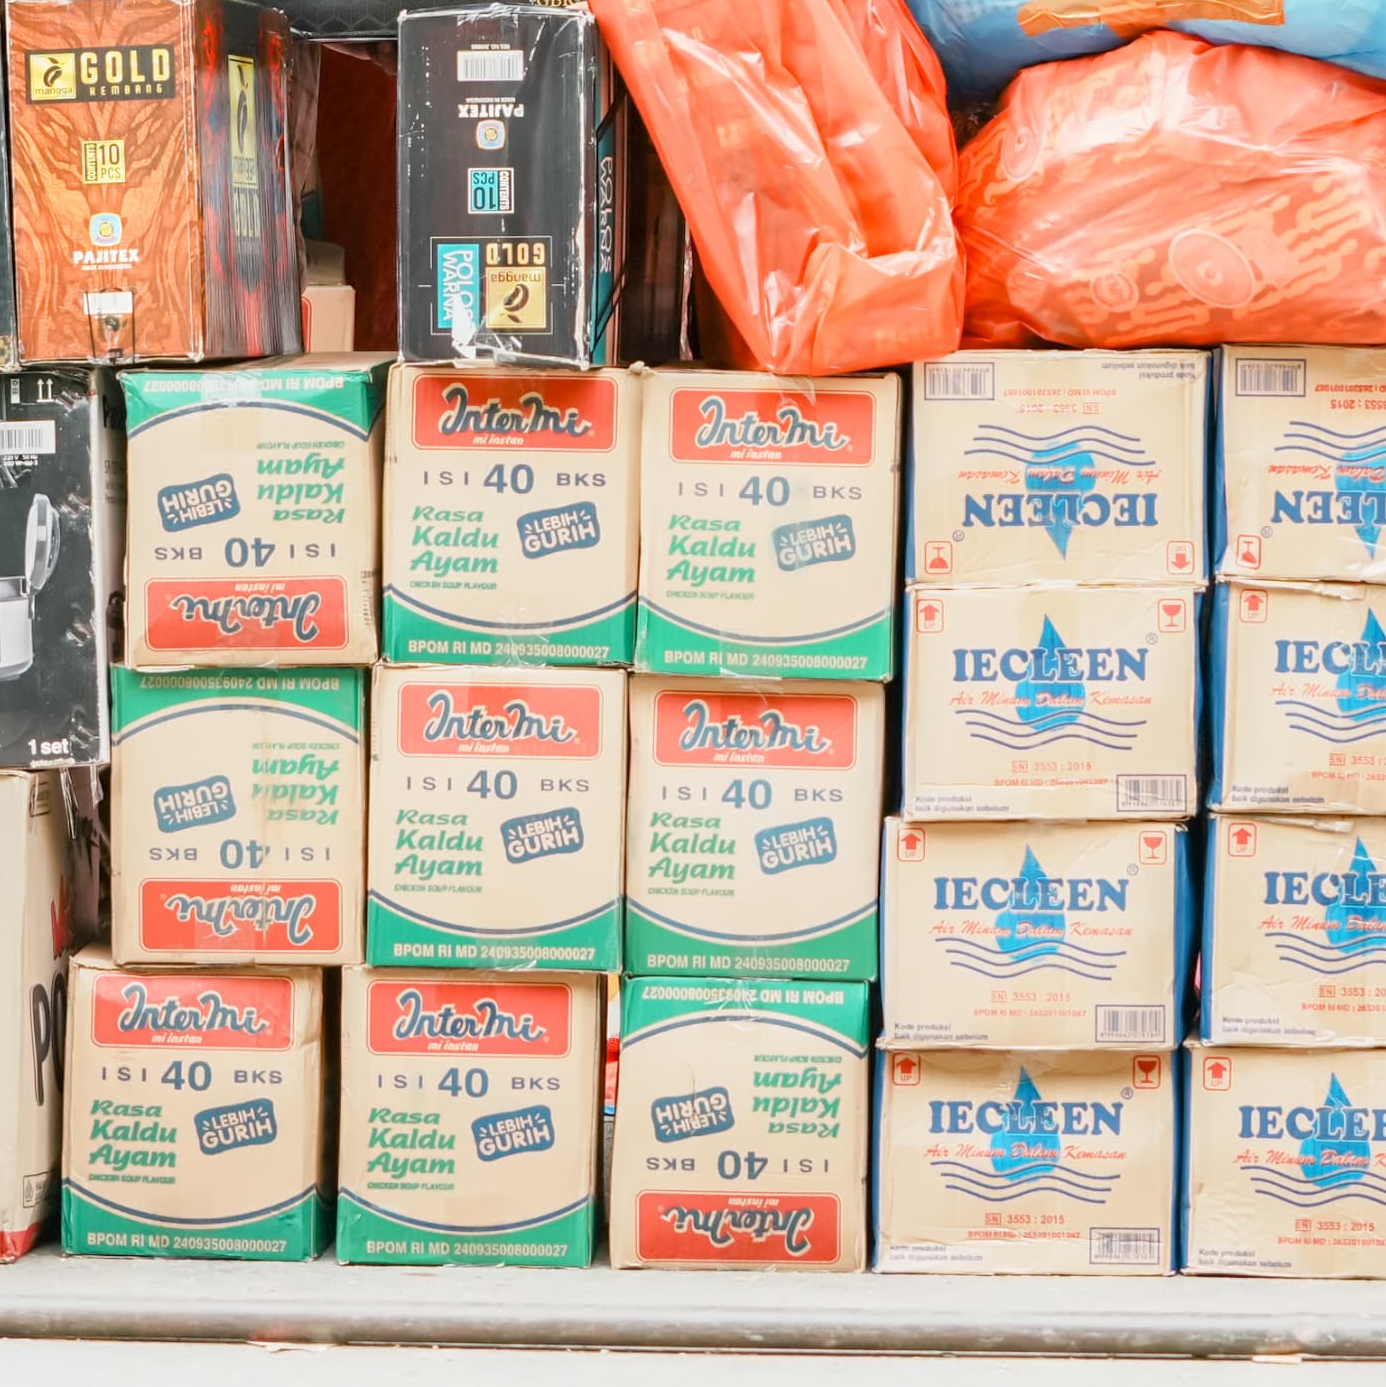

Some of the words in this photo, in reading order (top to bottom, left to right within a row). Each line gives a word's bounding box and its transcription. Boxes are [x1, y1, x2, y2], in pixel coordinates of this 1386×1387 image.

[80, 48, 171, 85] GOLD
[35, 85, 73, 96] mangga
[458, 104, 524, 118] PAJITEX
[84, 143, 97, 181] CONTENTS
[98, 143, 120, 166] 10
[101, 167, 121, 180] PCS
[473, 171, 496, 184] PCS
[473, 186, 496, 209] 10
[499, 171, 510, 210] CONTENTS
[233, 191, 260, 238] GOLD
[73, 249, 140, 264] PAJITEX
[486, 242, 546, 264] GOLD
[491, 273, 541, 286] mangga
[483, 464, 534, 494] 40
[556, 473, 606, 487] BKS
[257, 483, 345, 503] Kaldu
[738, 476, 791, 507] 40
[962, 492, 1159, 527] IECLEEN
[534, 510, 578, 533] LEBIH
[525, 522, 596, 553] GURIH
[224, 537, 275, 567] 40
[666, 560, 756, 587] Ayam
[952, 648, 1149, 682] IECLEEN
[295, 677, 340, 690] BPOM
[41, 738, 69, 754] set
[467, 769, 518, 800] 40
[158, 781, 228, 812] GURIH
[395, 809, 468, 826] Rasa
[650, 832, 736, 855] Kaldu
[393, 943, 434, 957] BPOM
[438, 944, 452, 957] RI
[455, 944, 477, 958] MD
[234, 1070, 283, 1084] BKS
[479, 1126, 550, 1155] GURIH
[923, 1144, 949, 1160] Air
[956, 1143, 1005, 1160] Minum
[1010, 1143, 1059, 1161] Dalam
[1065, 1144, 1127, 1160] Kemasan
[1007, 1214, 1032, 1224] 3553
[1040, 1214, 1065, 1225] 2015
